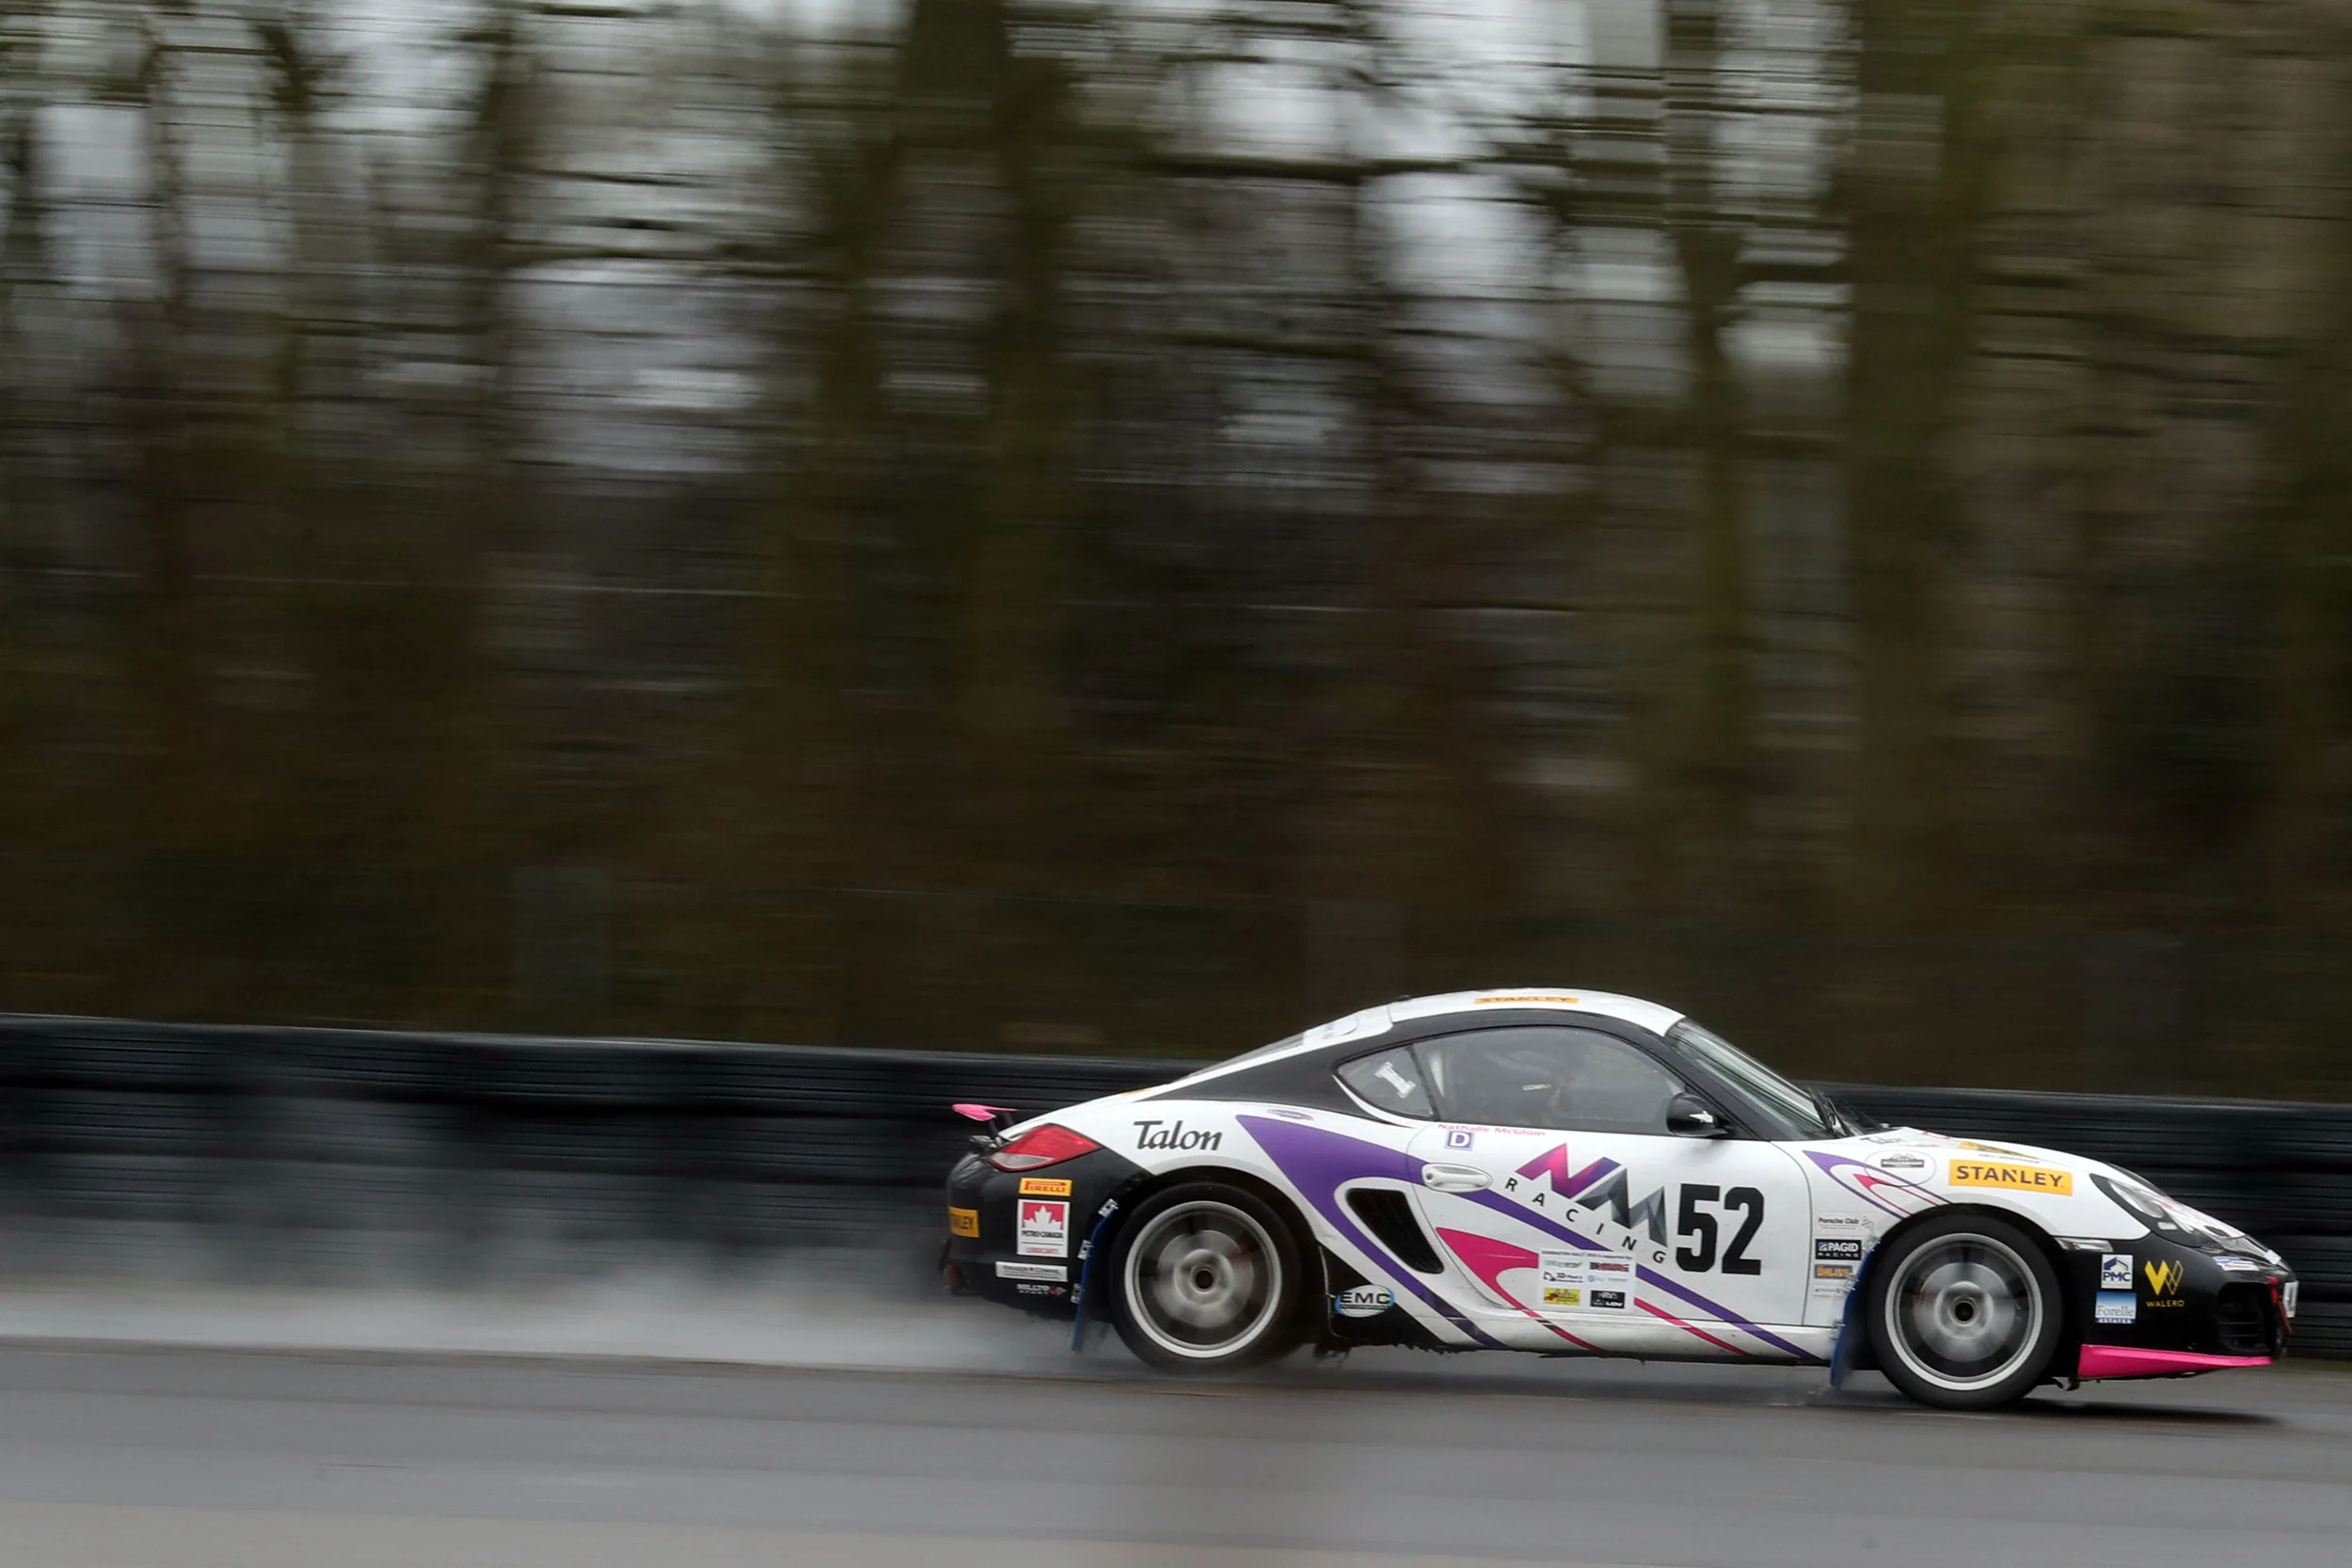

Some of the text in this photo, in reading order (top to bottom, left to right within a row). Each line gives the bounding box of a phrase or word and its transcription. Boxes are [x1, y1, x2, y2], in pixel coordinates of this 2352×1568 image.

[1134, 1120, 1223, 1151] Talon
[1450, 1132, 1470, 1148] D
[1956, 1165, 2063, 1188] STANLEY
[1025, 1180, 1067, 1194] PIRELLI
[1504, 1178, 1667, 1264] RACING
[1676, 1183, 1765, 1275] 52
[1828, 1242, 1859, 1252] PAGID
[2103, 1271, 2131, 1282] PMC
[1342, 1292, 1391, 1304] EMC
[2146, 1299, 2185, 1307] WALERO
